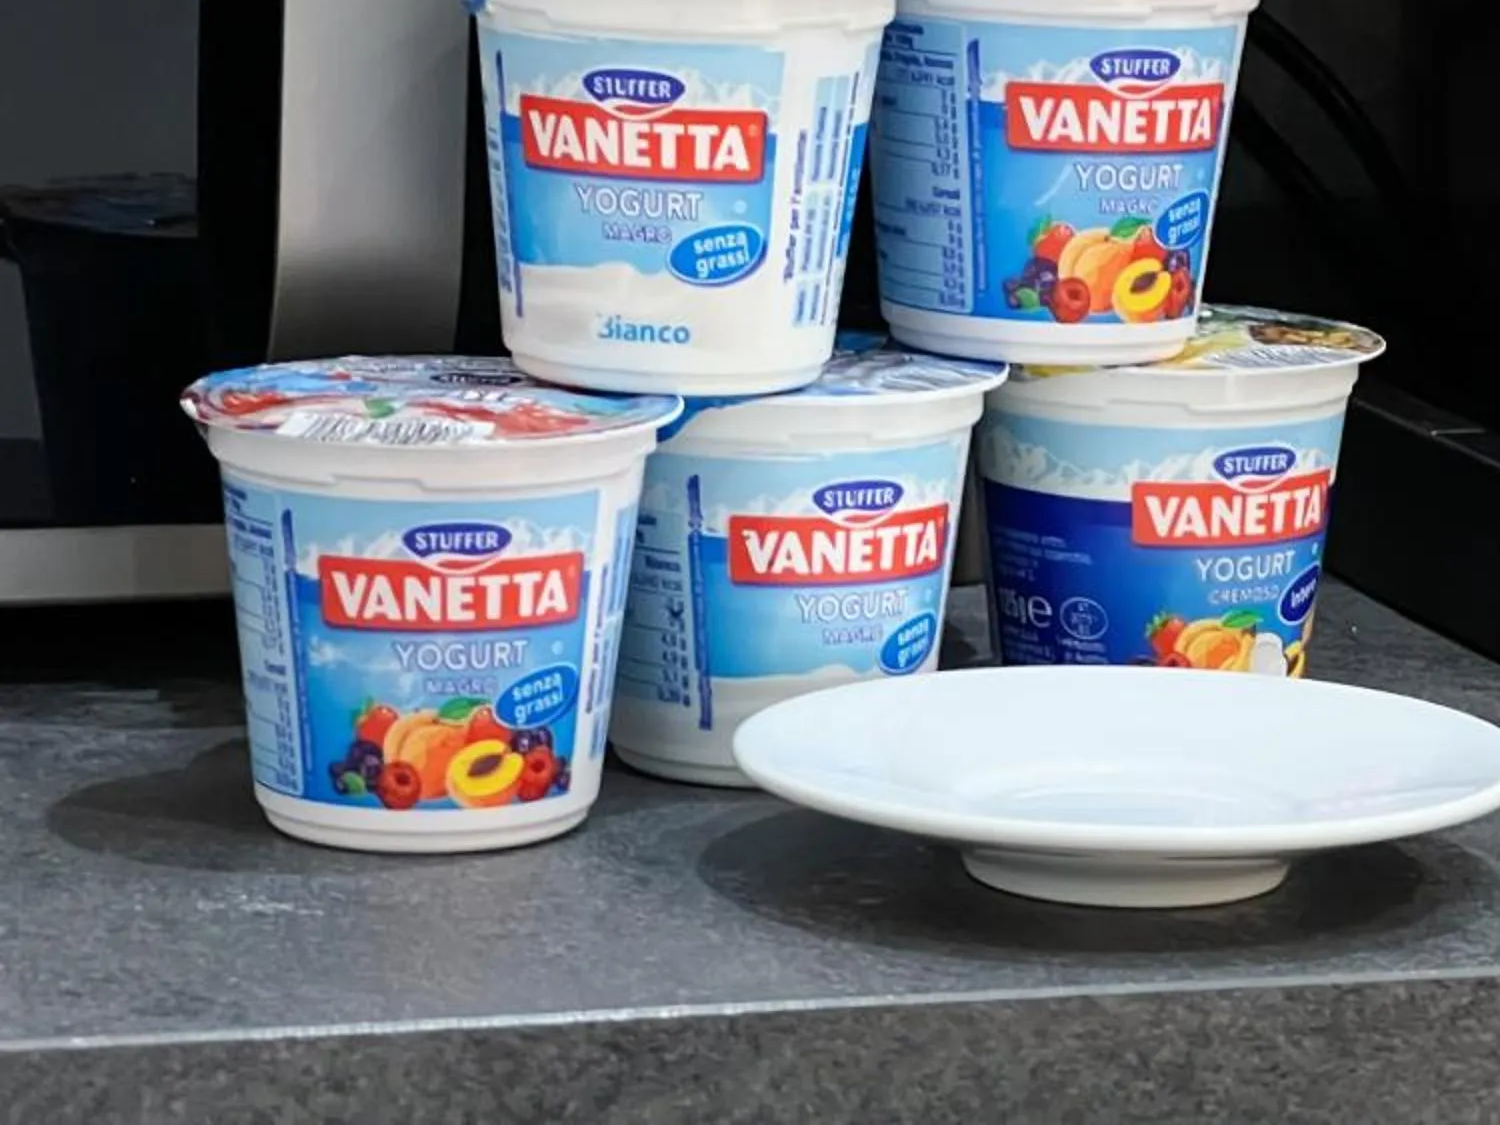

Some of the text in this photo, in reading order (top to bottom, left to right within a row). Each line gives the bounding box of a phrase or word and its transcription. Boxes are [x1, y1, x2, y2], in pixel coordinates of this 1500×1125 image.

[1101, 58, 1171, 77] STUFFER
[1019, 96, 1212, 145] VANETTA
[528, 109, 750, 172] VANETTA
[1076, 163, 1183, 192] YOGURT
[575, 183, 704, 221] YOGURT
[693, 230, 747, 255] senza
[695, 248, 750, 279] grassi
[1223, 452, 1287, 474] STUFFER
[1144, 486, 1323, 538] VANETTA
[415, 530, 499, 551] STUFFER
[742, 519, 938, 575] VANETTA
[1196, 549, 1296, 582] YOGURT
[331, 570, 568, 623] VANETTA
[799, 589, 908, 623] YOGURT
[394, 639, 528, 671] YOGURT
[512, 672, 562, 701] senza
[515, 691, 563, 724] grassi
